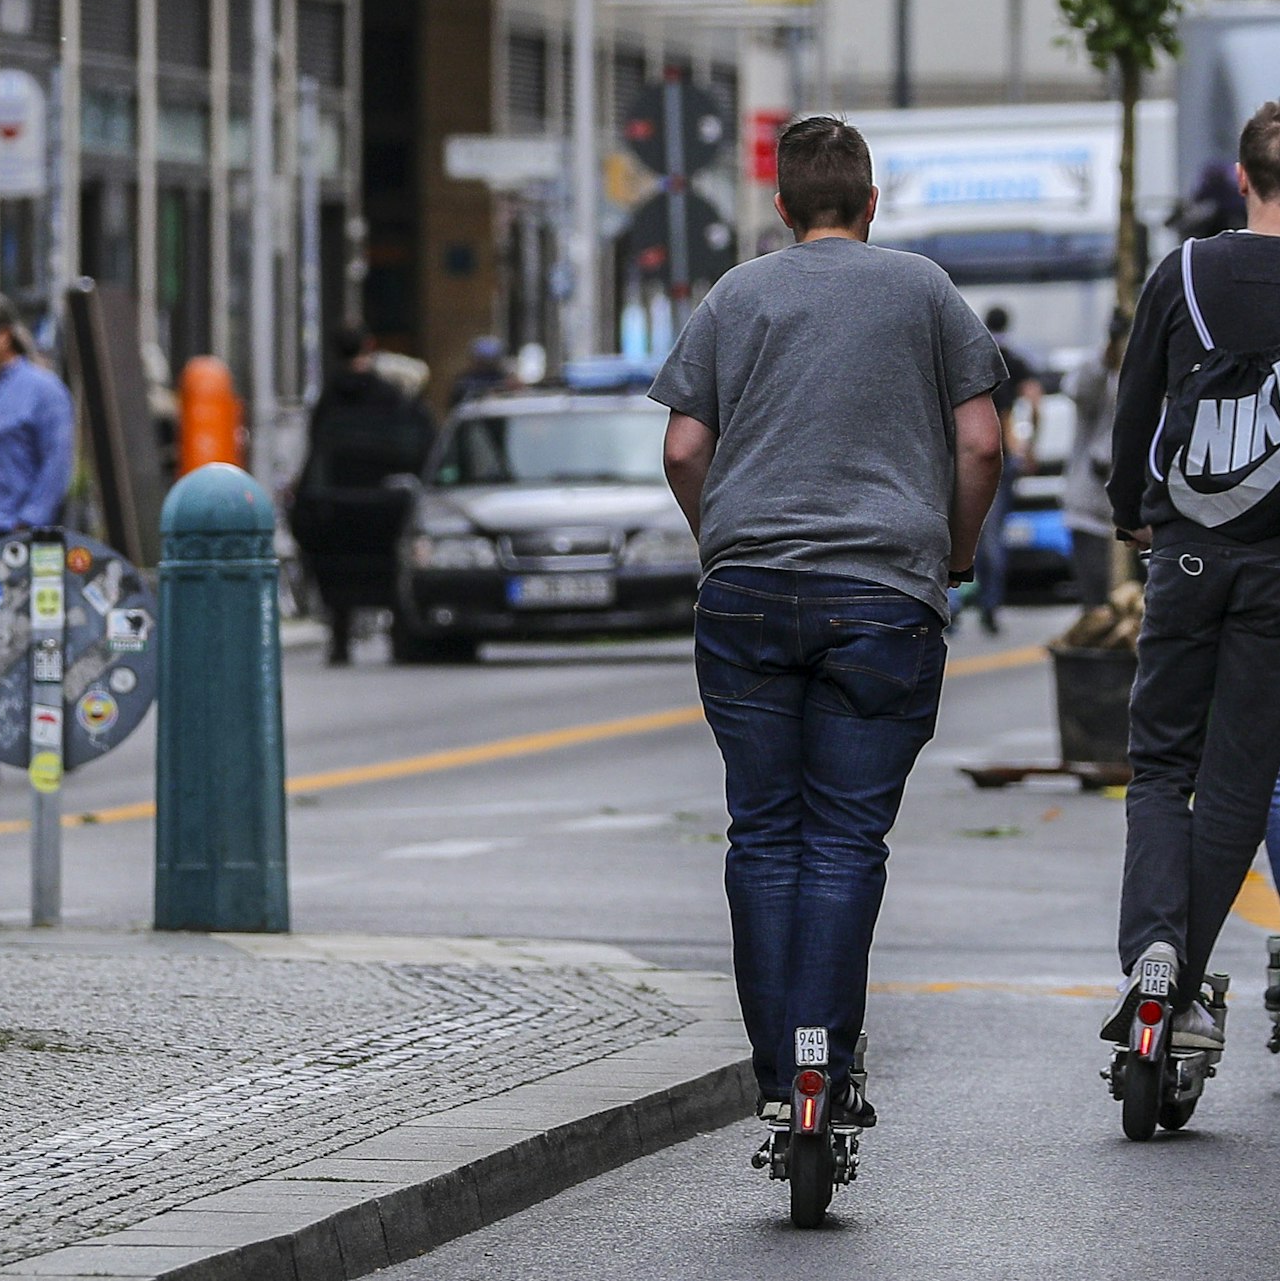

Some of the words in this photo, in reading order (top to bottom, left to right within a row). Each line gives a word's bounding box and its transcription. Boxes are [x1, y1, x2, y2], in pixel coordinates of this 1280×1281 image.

[1145, 962, 1169, 978] 092
[1144, 978, 1167, 994] IAE
[799, 1030, 824, 1046] 940
[801, 1047, 825, 1062] IBJ
